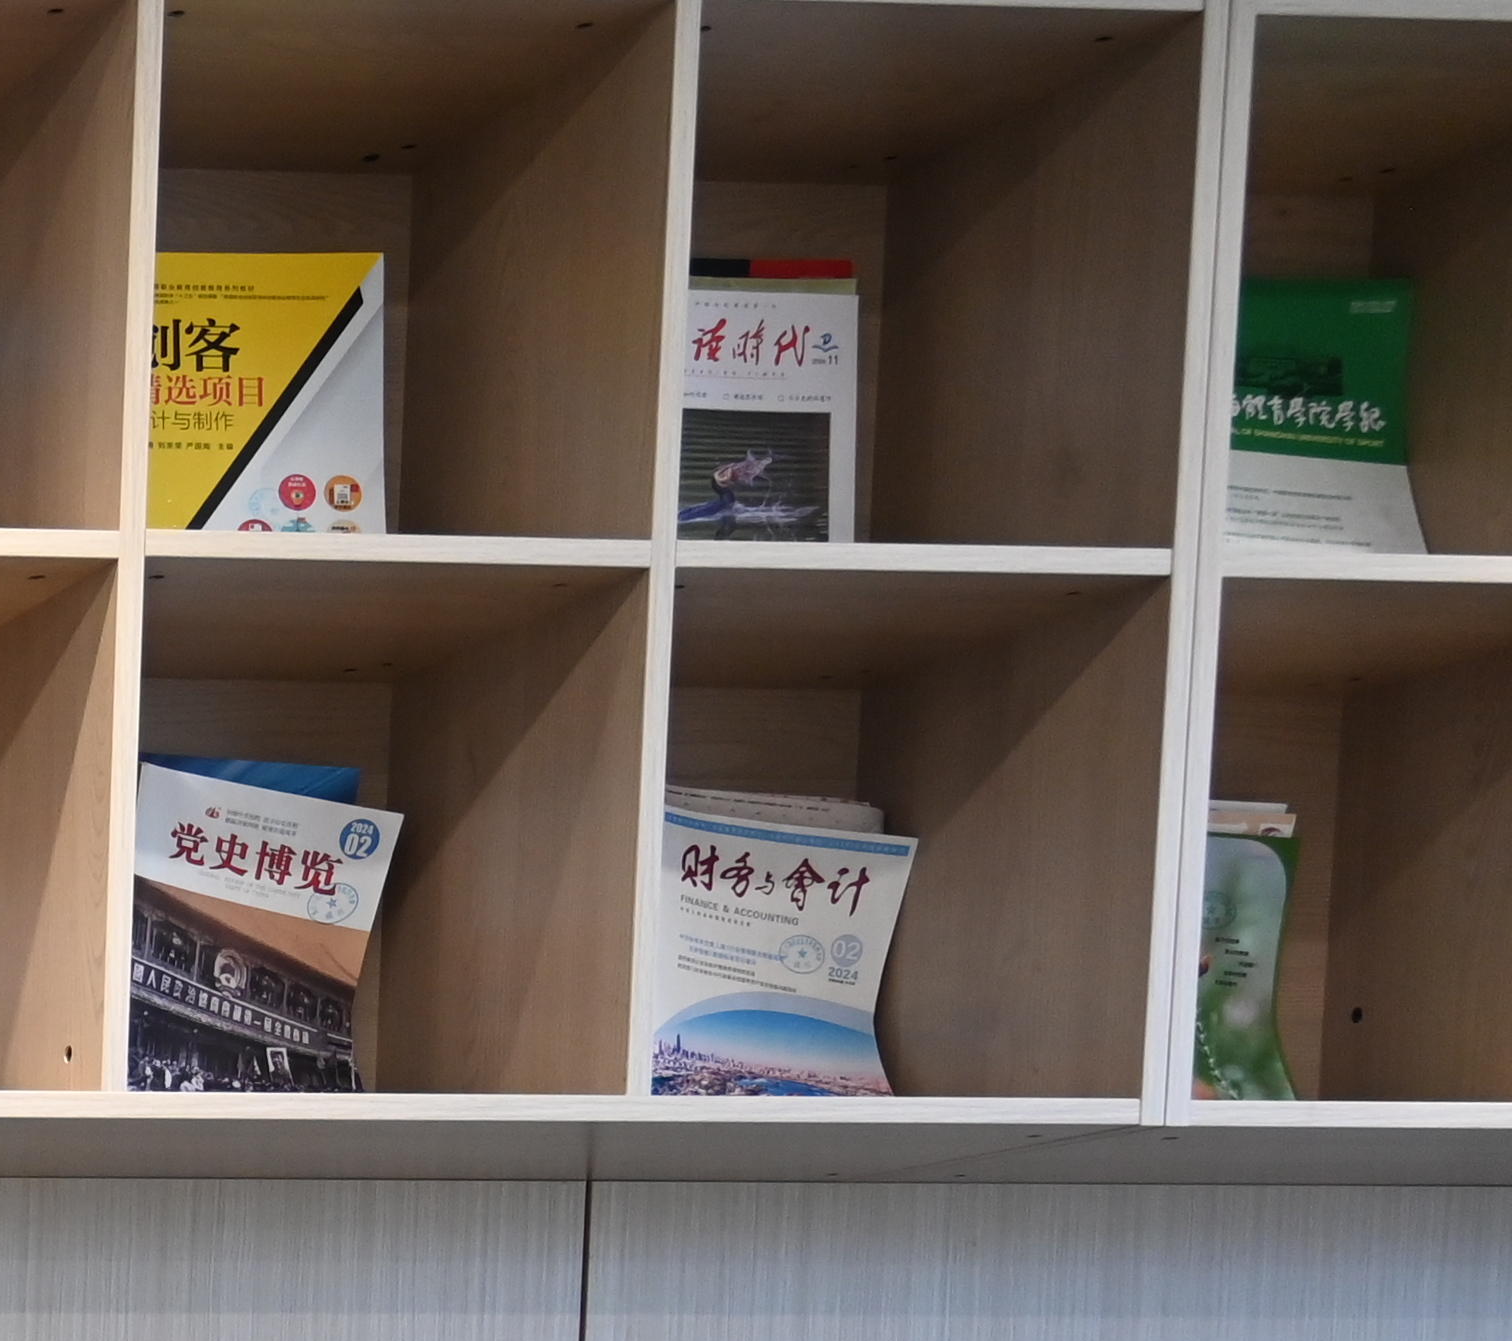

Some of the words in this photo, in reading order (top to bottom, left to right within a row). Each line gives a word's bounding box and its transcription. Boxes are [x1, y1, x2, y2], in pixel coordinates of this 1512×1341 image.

[350, 822, 374, 835] 2024
[344, 834, 372, 859] 02
[169, 822, 344, 896] 党史博览
[680, 895, 718, 912] FINANCE
[722, 904, 729, 913] &
[734, 907, 799, 926] ACCOUNTING
[832, 940, 860, 960] 02
[828, 967, 858, 980] 2024
